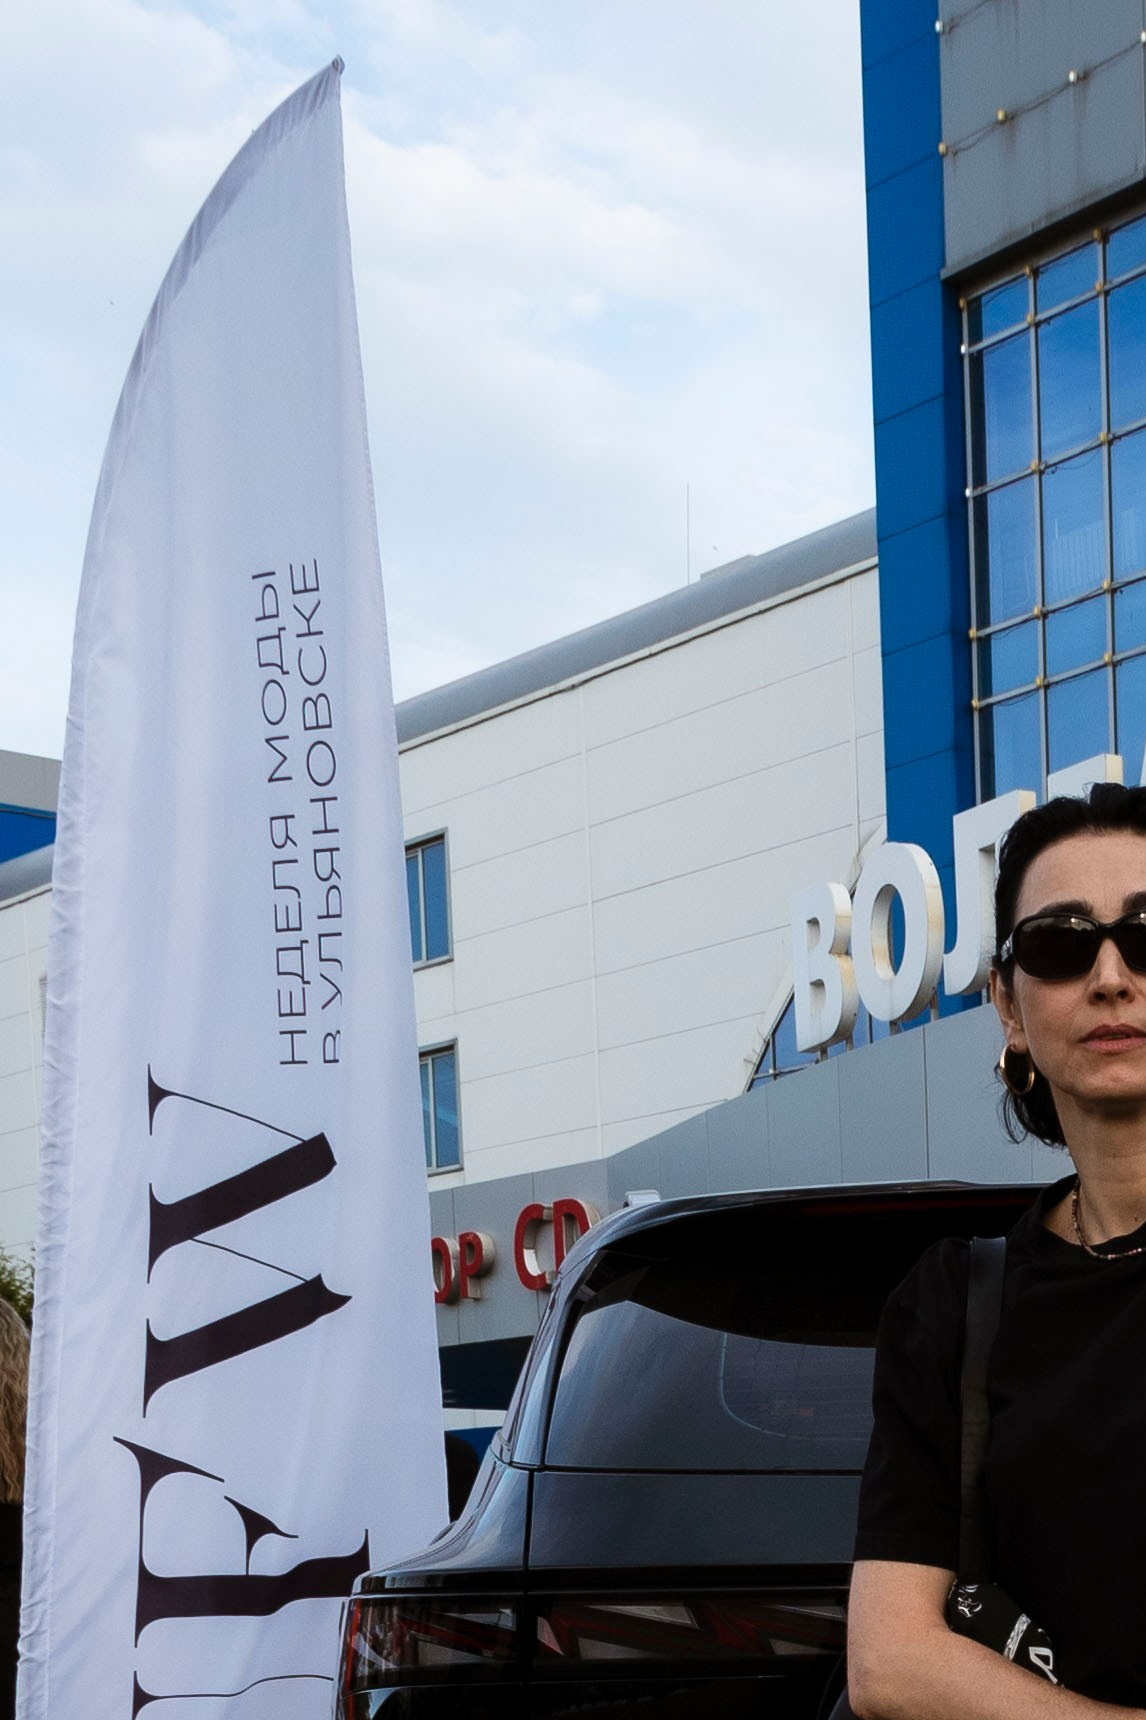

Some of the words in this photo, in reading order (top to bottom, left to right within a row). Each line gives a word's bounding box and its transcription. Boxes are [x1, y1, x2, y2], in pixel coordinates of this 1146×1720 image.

[252, 571, 294, 783] МОДЫ
[289, 558, 343, 1006] УЛЬЯНОВСКЕ
[269, 813, 310, 1065] НЕДЕЛЯ
